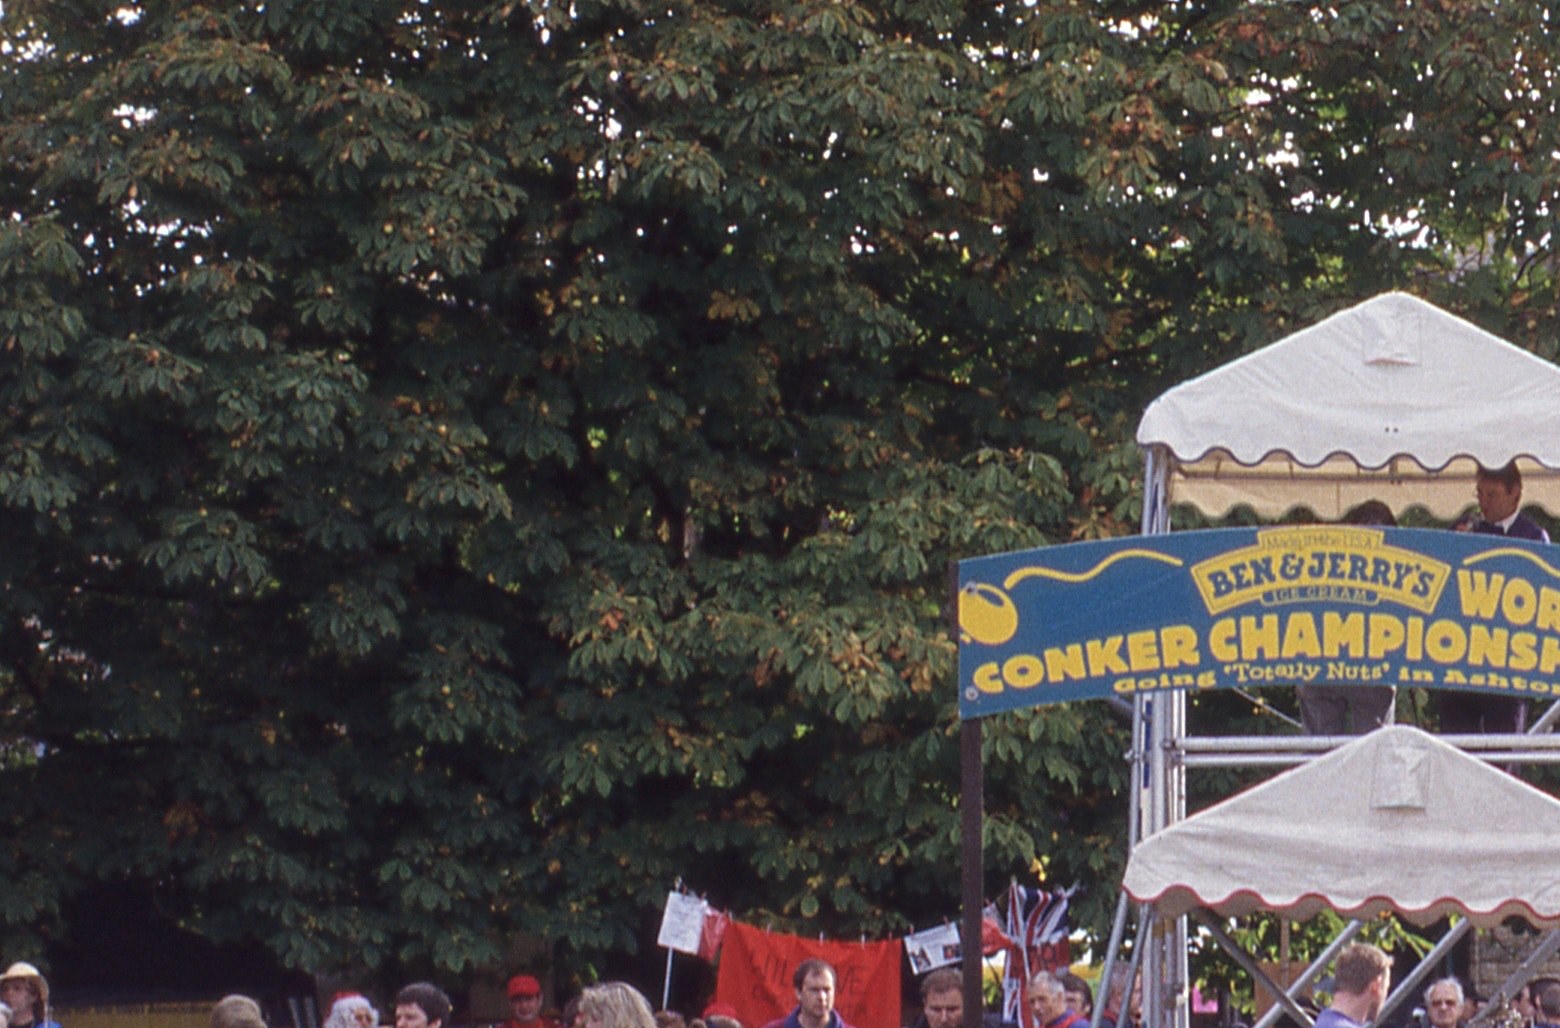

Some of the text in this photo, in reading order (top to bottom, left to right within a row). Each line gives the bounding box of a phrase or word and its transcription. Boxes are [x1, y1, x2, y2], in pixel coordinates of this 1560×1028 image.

[1208, 552, 1435, 598] BEN & JERRY'S
[1273, 587, 1367, 601] ICE CREAM
[973, 625, 1200, 693] CONKER
[1114, 670, 1216, 692] Going
[1399, 667, 1434, 682] in
